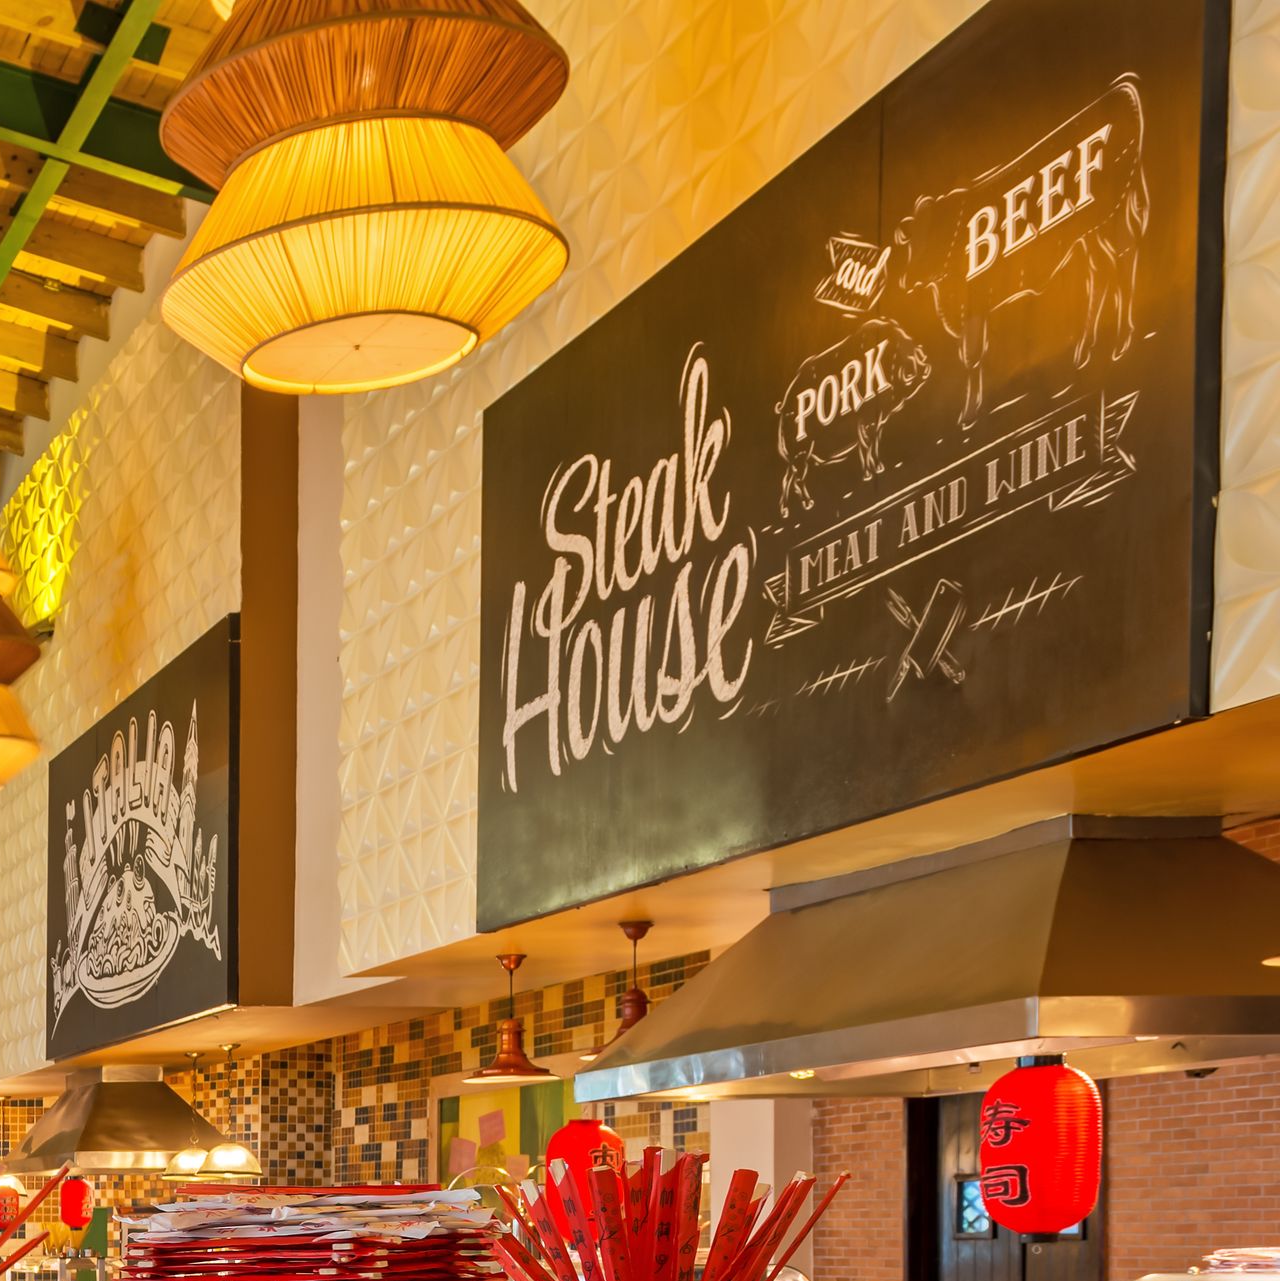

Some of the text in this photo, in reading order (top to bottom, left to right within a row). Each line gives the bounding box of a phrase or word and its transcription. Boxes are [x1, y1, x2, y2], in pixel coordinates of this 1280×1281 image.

[834, 246, 891, 296] and
[965, 123, 1113, 282] BEEF
[794, 338, 894, 443] PORK
[535, 356, 731, 637] Steak
[798, 413, 1087, 596] MEAT AND WINE
[502, 543, 753, 794] House
[81, 708, 176, 865] ITALIA
[981, 1099, 1032, 1207] 寿司
